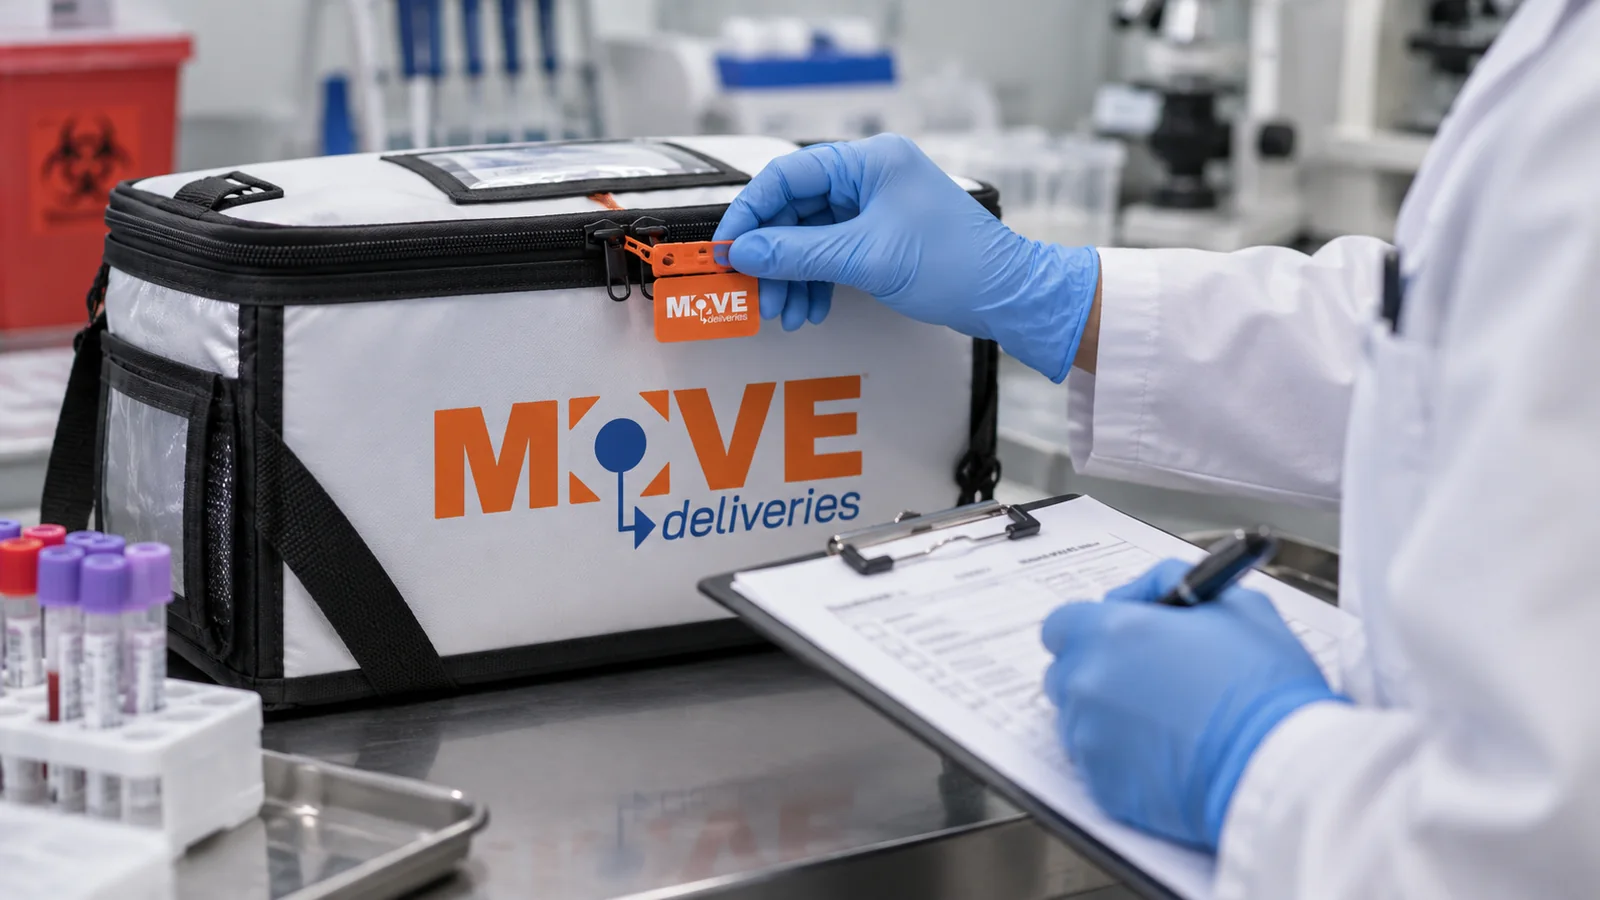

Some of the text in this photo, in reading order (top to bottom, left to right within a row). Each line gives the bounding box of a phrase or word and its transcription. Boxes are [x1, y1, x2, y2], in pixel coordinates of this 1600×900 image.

[666, 291, 747, 318] MOVE
[707, 313, 748, 323] deliveries
[434, 375, 863, 519] MOVE
[661, 488, 861, 541] deliveries
